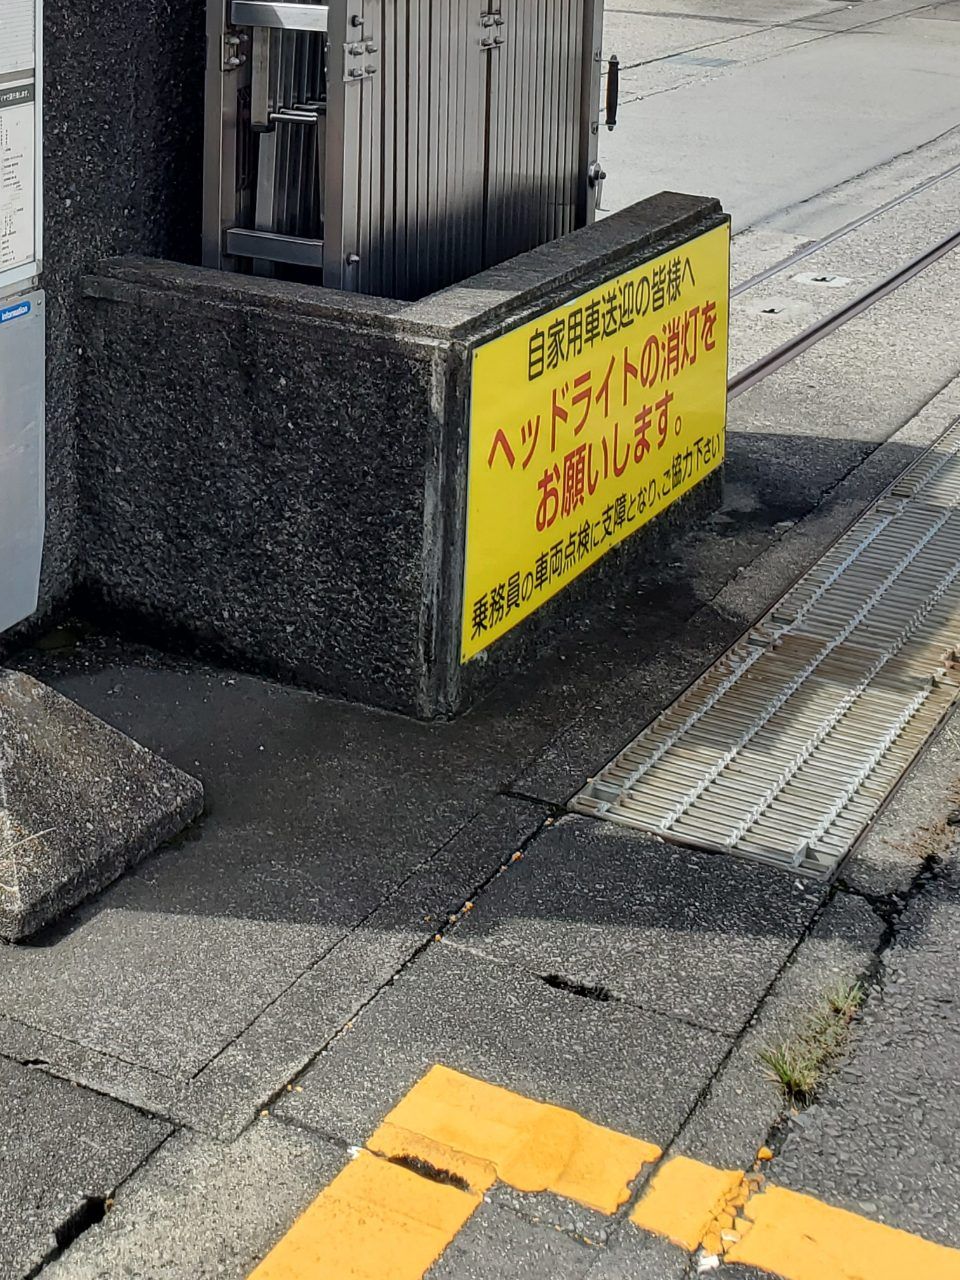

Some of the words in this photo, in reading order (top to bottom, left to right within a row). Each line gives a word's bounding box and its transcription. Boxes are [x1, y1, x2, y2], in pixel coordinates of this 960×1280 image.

[488, 300, 717, 470] ヘッドライトの消灯を
[528, 257, 696, 382] 自家用車送迎の皆様へ
[471, 432, 721, 641] 乗務員の車両点検に支障となり、ご協力下さい
[536, 389, 682, 532] お願いします。
